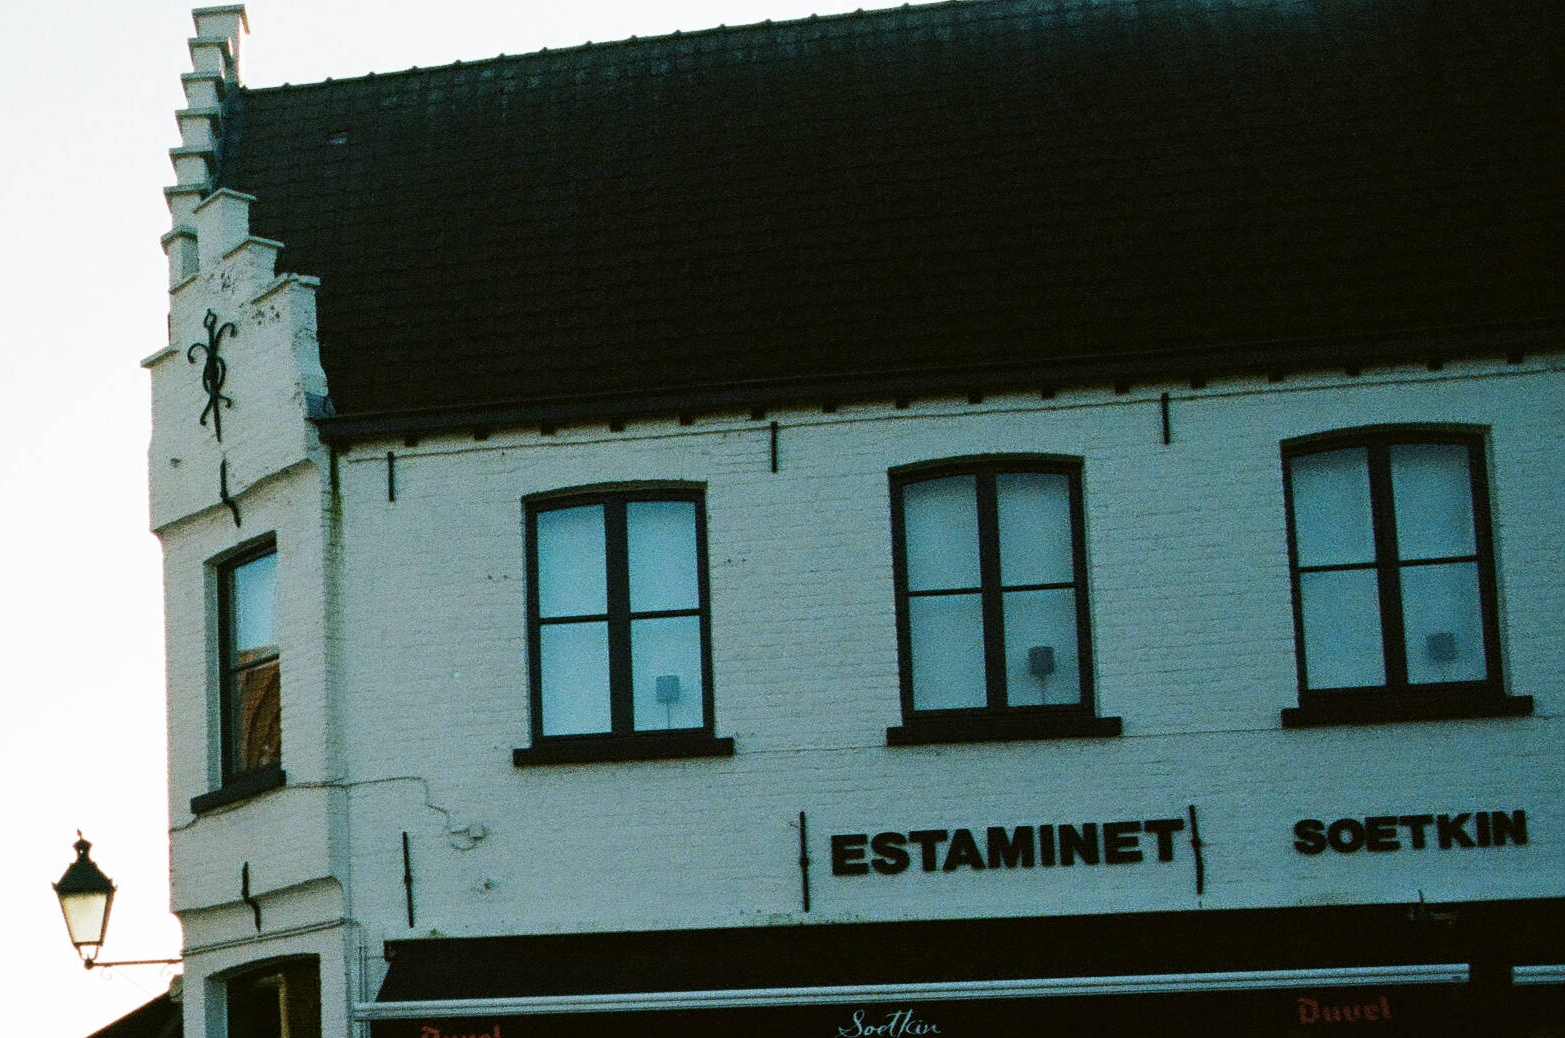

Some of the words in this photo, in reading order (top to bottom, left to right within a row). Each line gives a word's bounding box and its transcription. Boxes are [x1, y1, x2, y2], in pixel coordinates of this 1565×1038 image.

[831, 818, 1184, 876] ESTAMINET
[1293, 809, 1528, 855] SOETKIN
[835, 1009, 942, 1038] Soetkin
[1298, 997, 1393, 1024] Duvel
